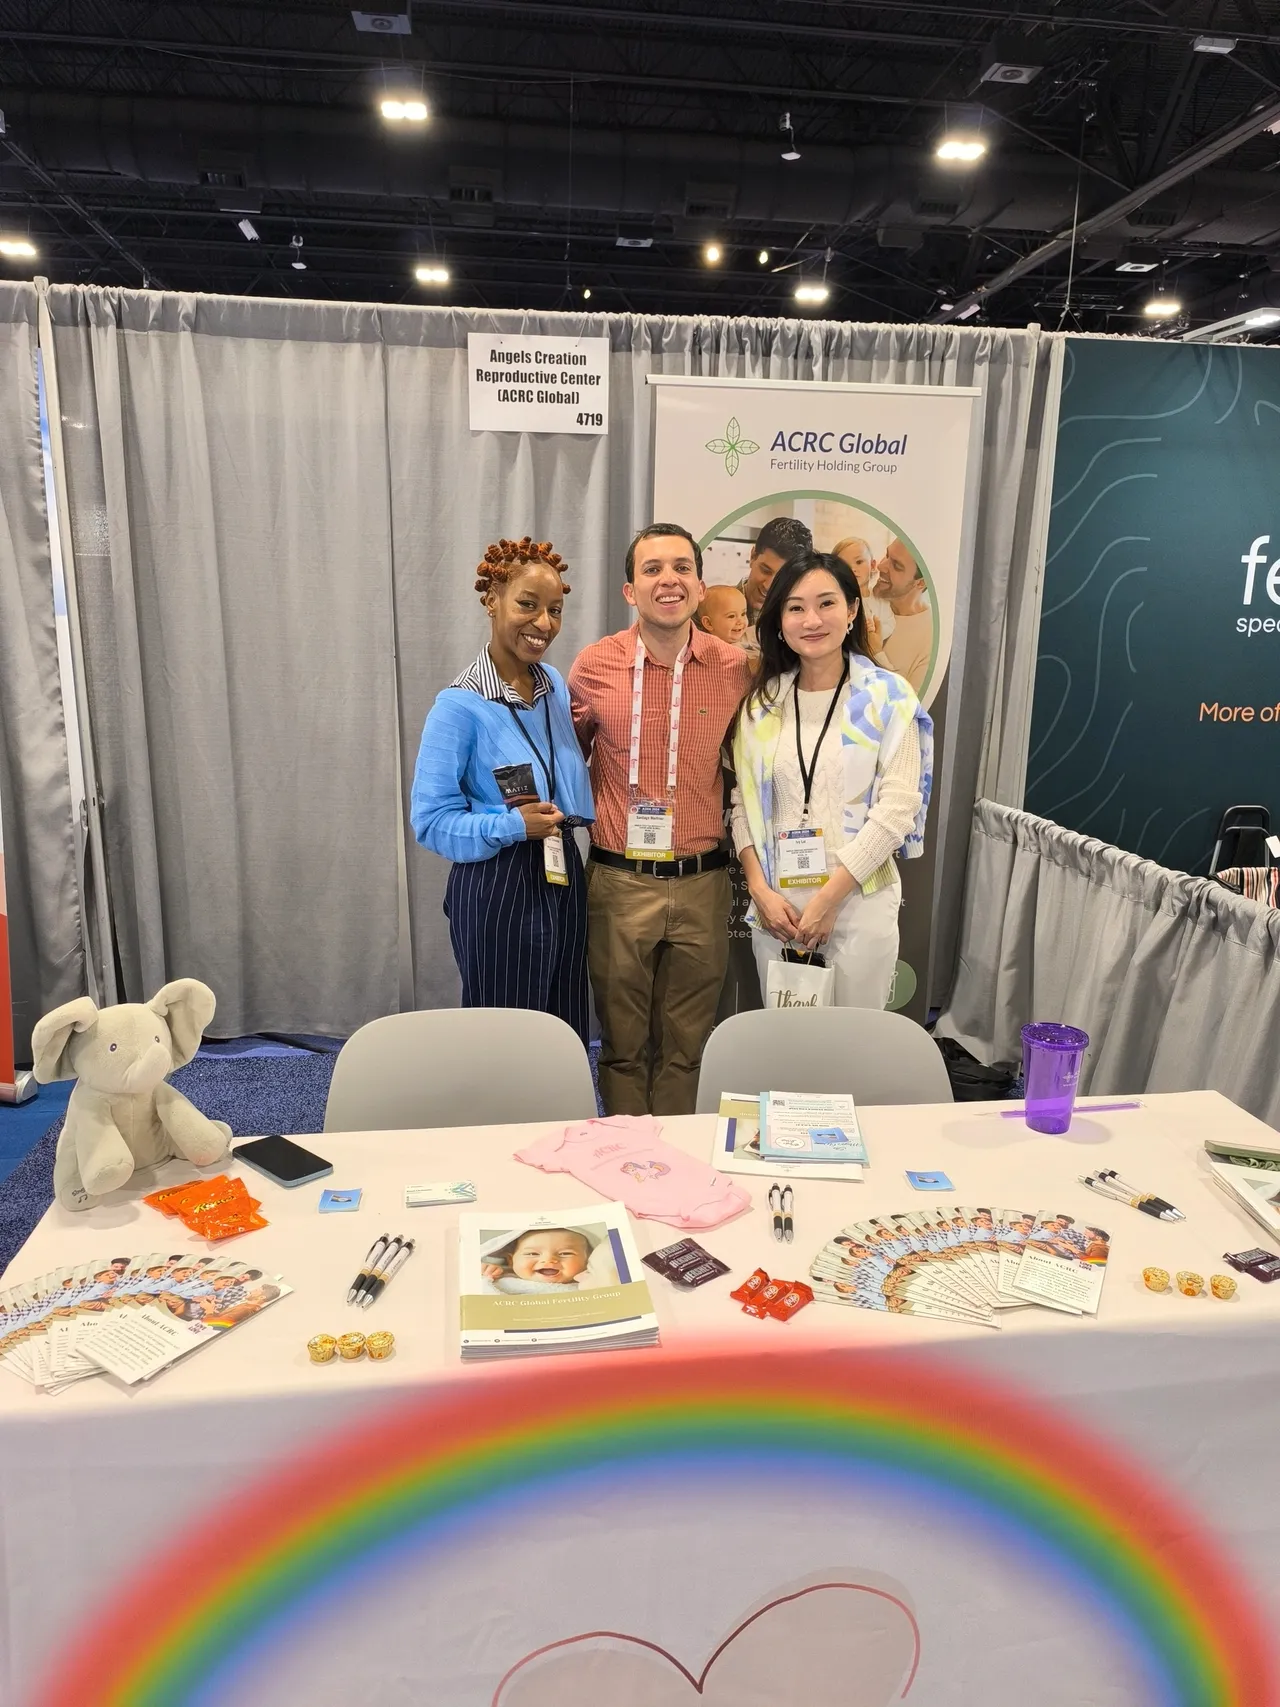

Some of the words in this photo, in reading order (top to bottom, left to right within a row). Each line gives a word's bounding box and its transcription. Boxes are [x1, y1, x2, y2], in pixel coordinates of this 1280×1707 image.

[490, 349, 532, 364] Angels
[535, 350, 587, 366] Creation
[476, 369, 557, 384] Reproductive
[560, 371, 601, 386] Center
[497, 389, 534, 403] (ACRC
[537, 390, 579, 405] Global)
[576, 412, 603, 426] 4719
[770, 431, 835, 453] ACRC
[839, 433, 908, 455] Global
[770, 458, 814, 472] Fertility
[817, 460, 860, 474] Holding
[863, 461, 897, 474] Group
[1199, 702, 1255, 722] More
[632, 850, 667, 858] EXHIBITOR
[787, 877, 822, 885] EXHIBITOR
[552, 1295, 590, 1304] Fertility
[592, 1291, 621, 1300] Group
